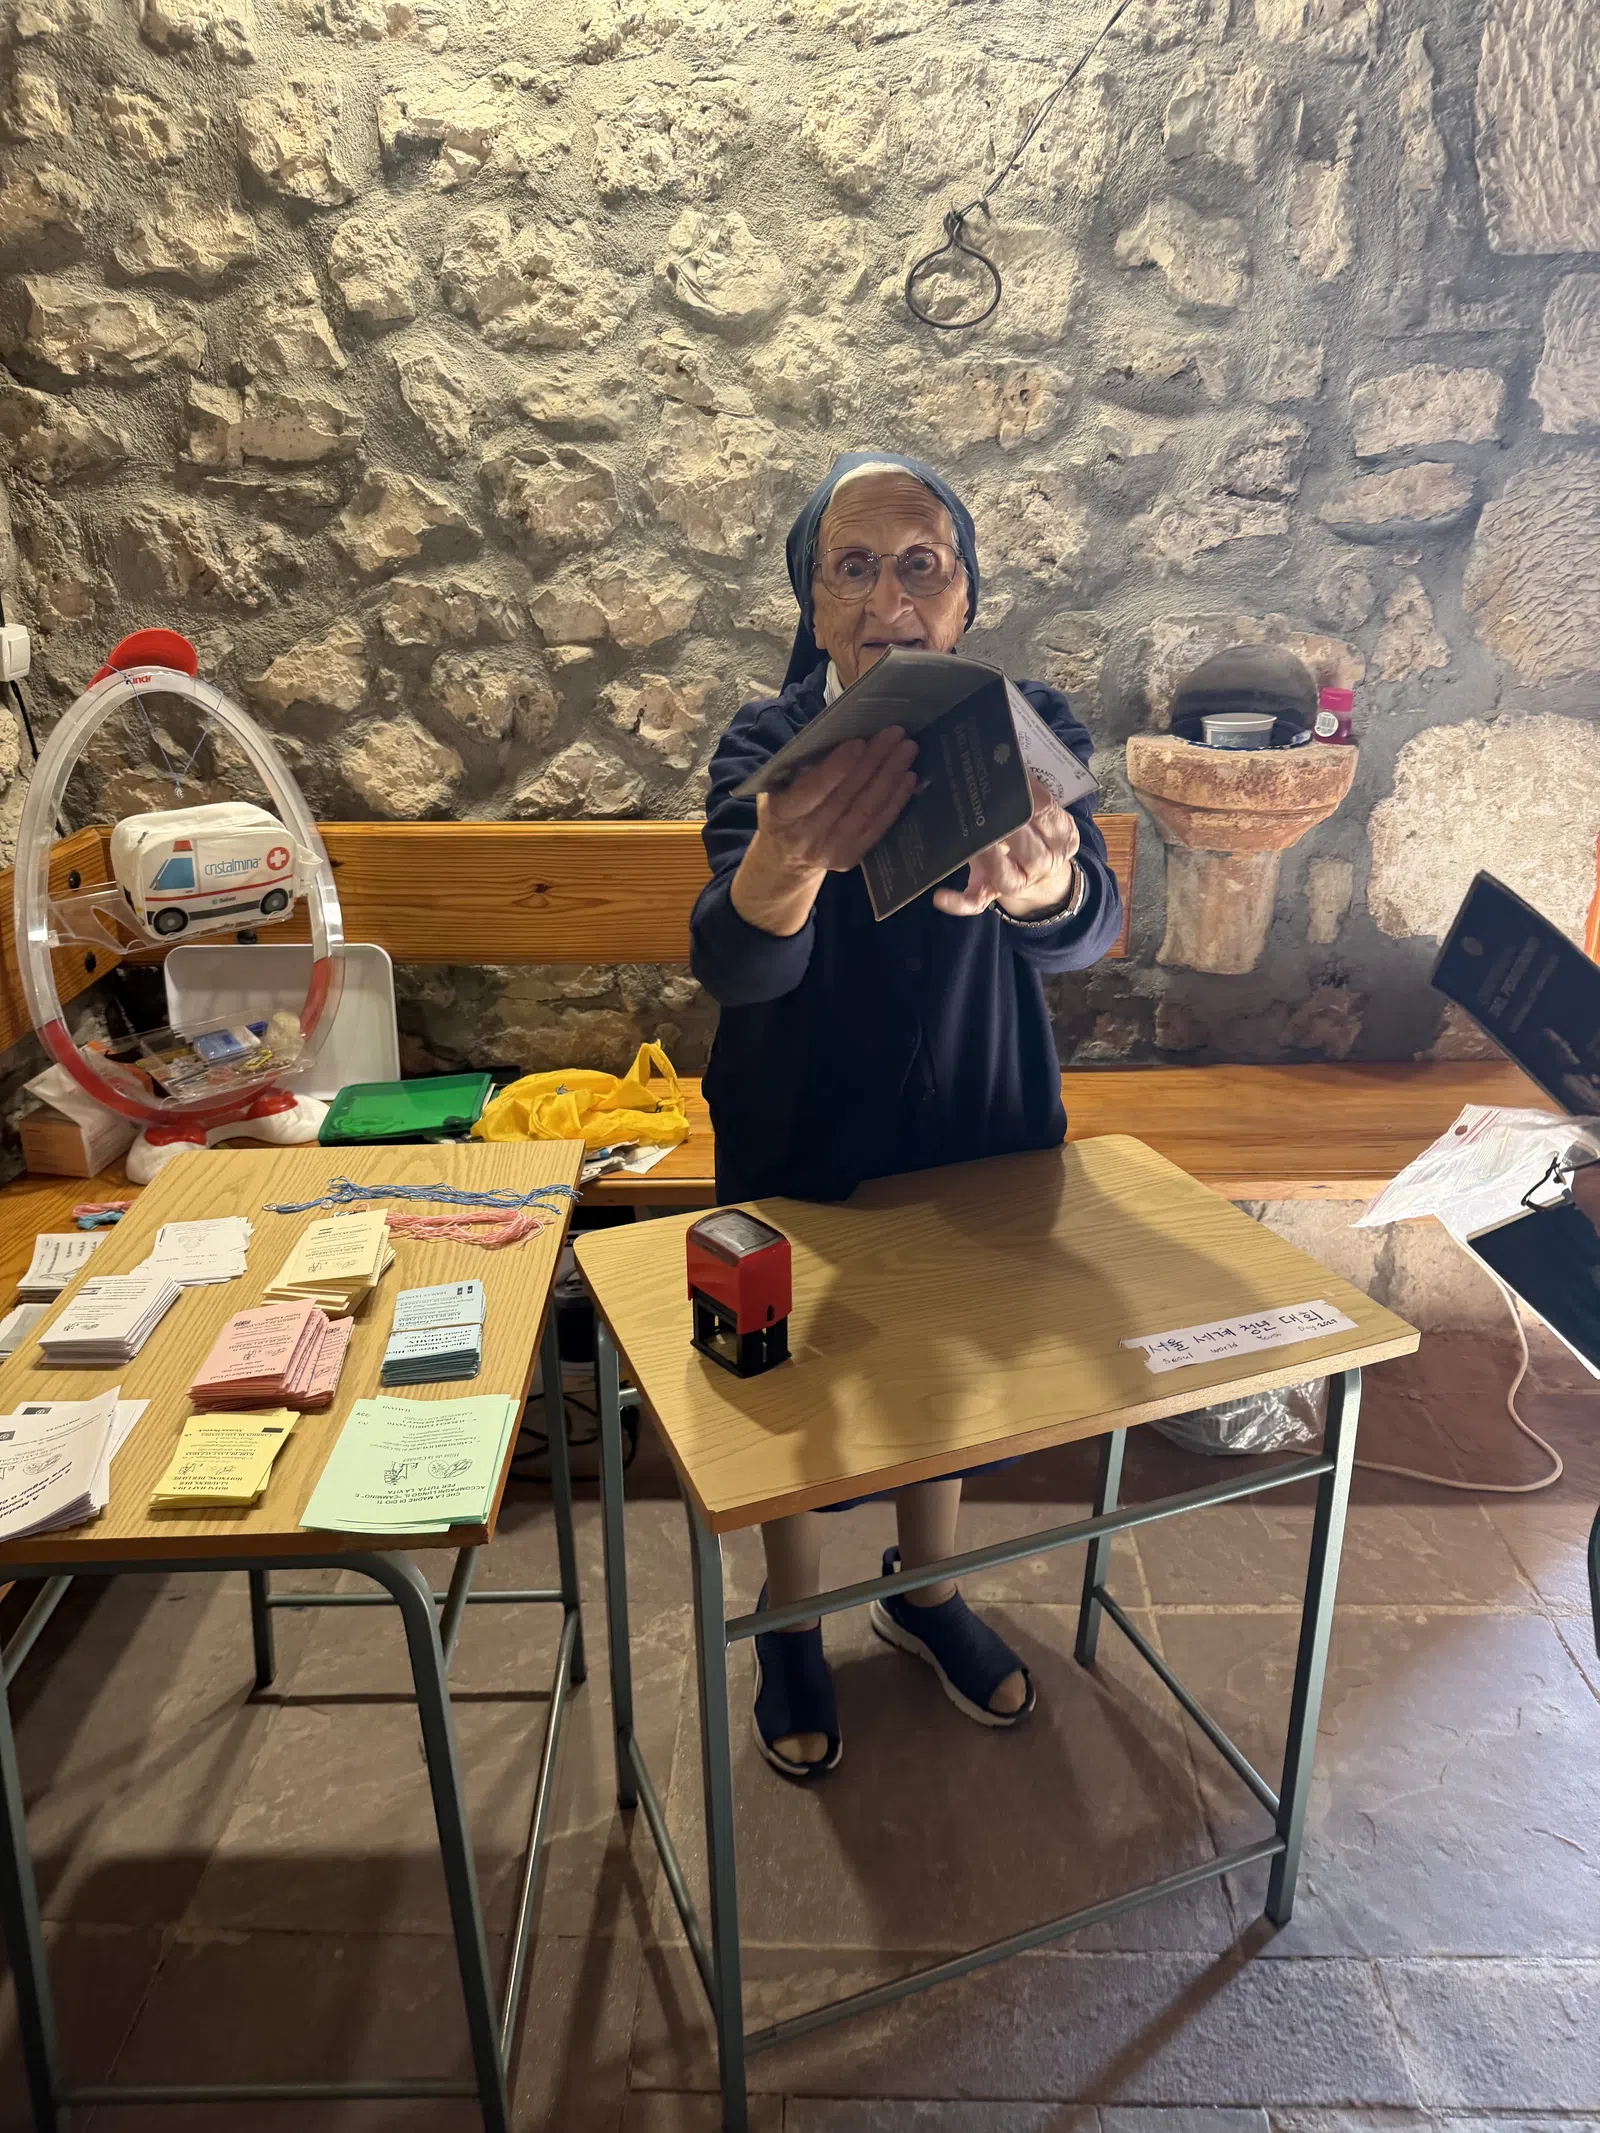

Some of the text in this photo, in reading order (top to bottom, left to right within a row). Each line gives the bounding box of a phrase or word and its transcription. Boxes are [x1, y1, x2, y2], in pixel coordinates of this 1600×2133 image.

[204, 857, 259, 876] cristalmina
[1148, 1309, 1324, 1355] 서울 세계 청년 대회
[19, 1477, 50, 1496] seguir
[438, 1485, 486, 1494] ACCOMPAGNI
